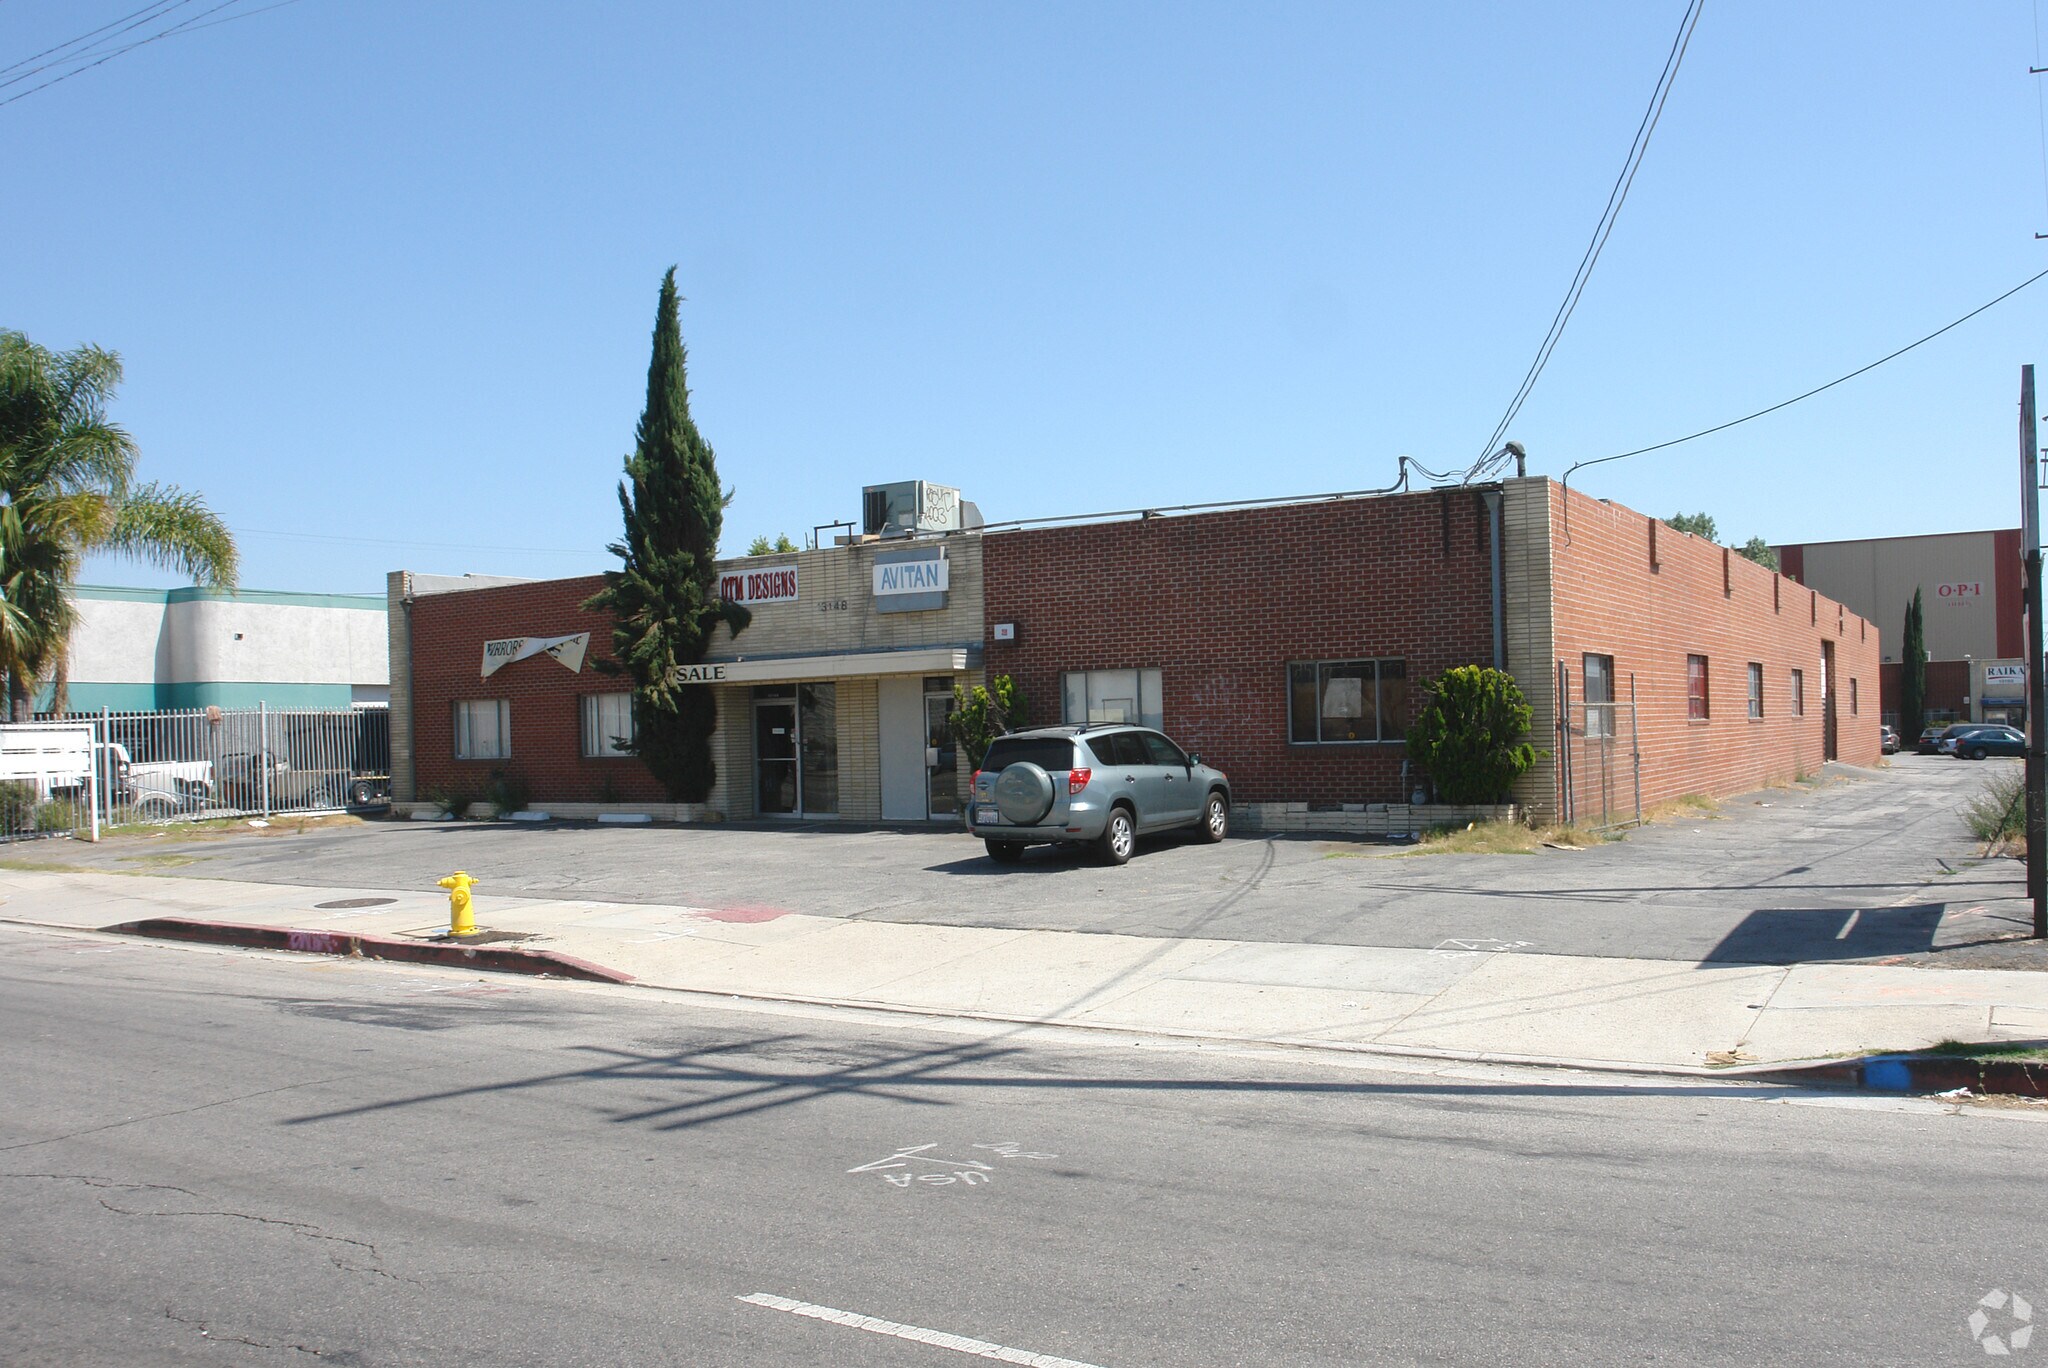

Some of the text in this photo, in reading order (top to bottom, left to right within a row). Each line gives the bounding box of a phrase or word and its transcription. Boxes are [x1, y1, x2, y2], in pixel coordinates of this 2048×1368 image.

[747, 570, 796, 600] DESIGNS
[881, 563, 938, 590] AVITAN
[676, 666, 726, 681] SALE
[883, 1171, 990, 1187] USA
